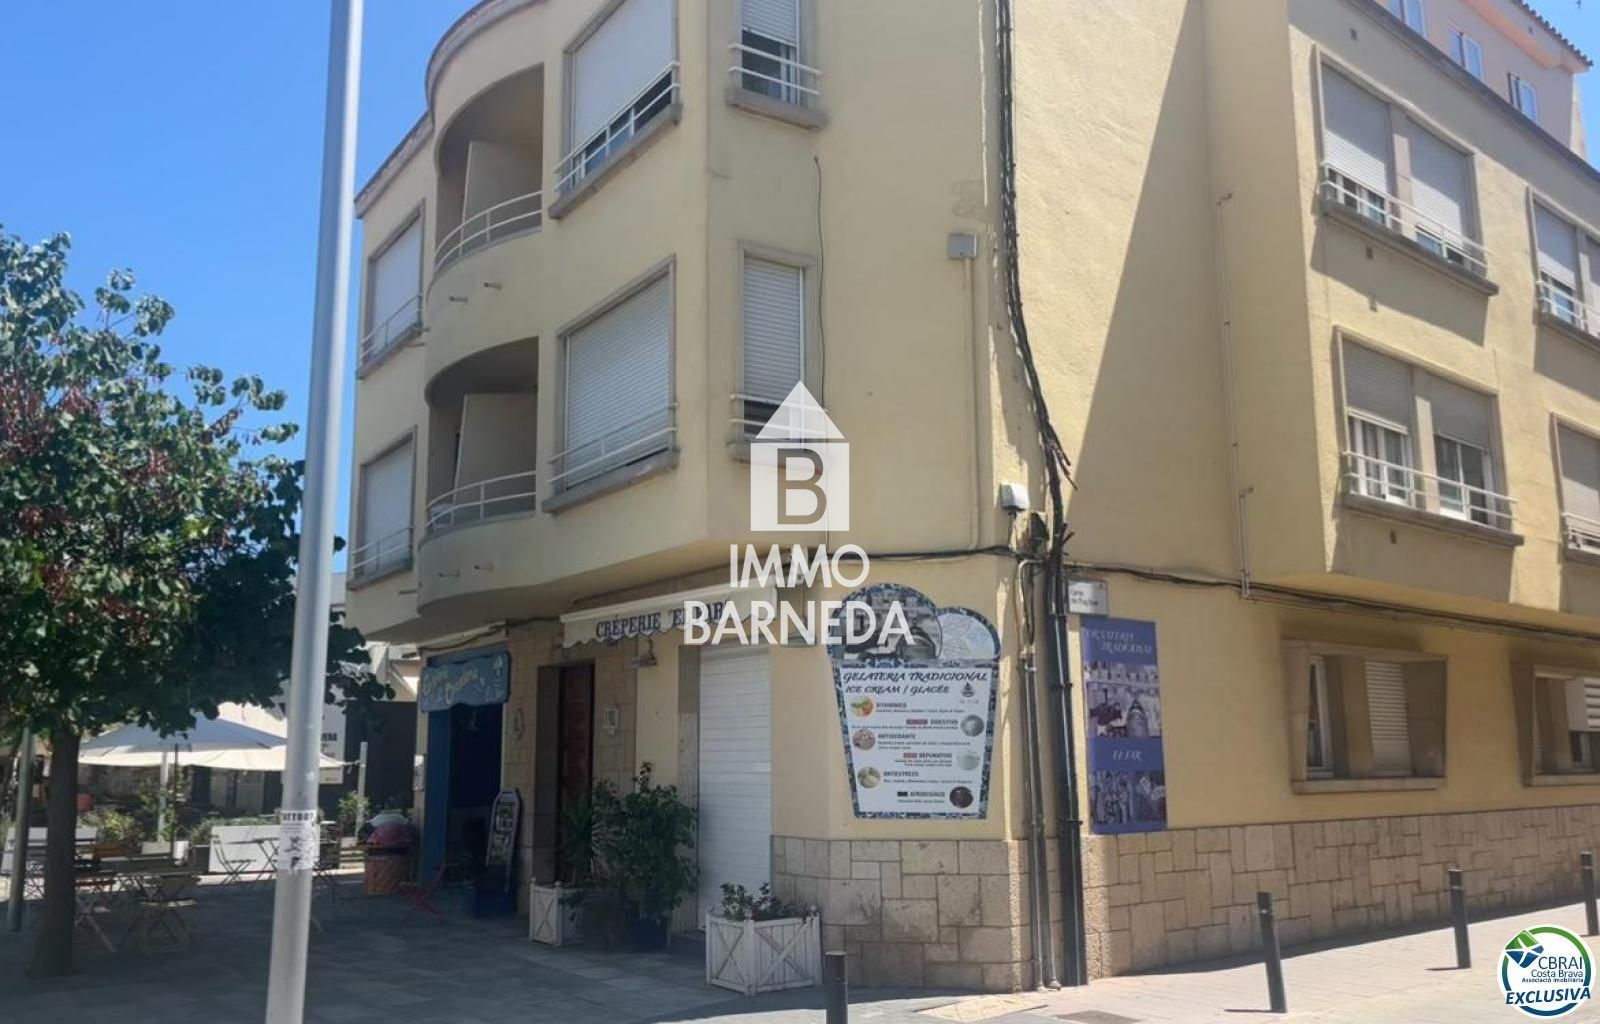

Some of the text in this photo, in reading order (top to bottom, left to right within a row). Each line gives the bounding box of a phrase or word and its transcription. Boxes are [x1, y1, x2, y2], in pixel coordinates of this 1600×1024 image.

[843, 671, 988, 683] GELATERIA TRADICIONAL
[864, 685, 900, 694] CREAM
